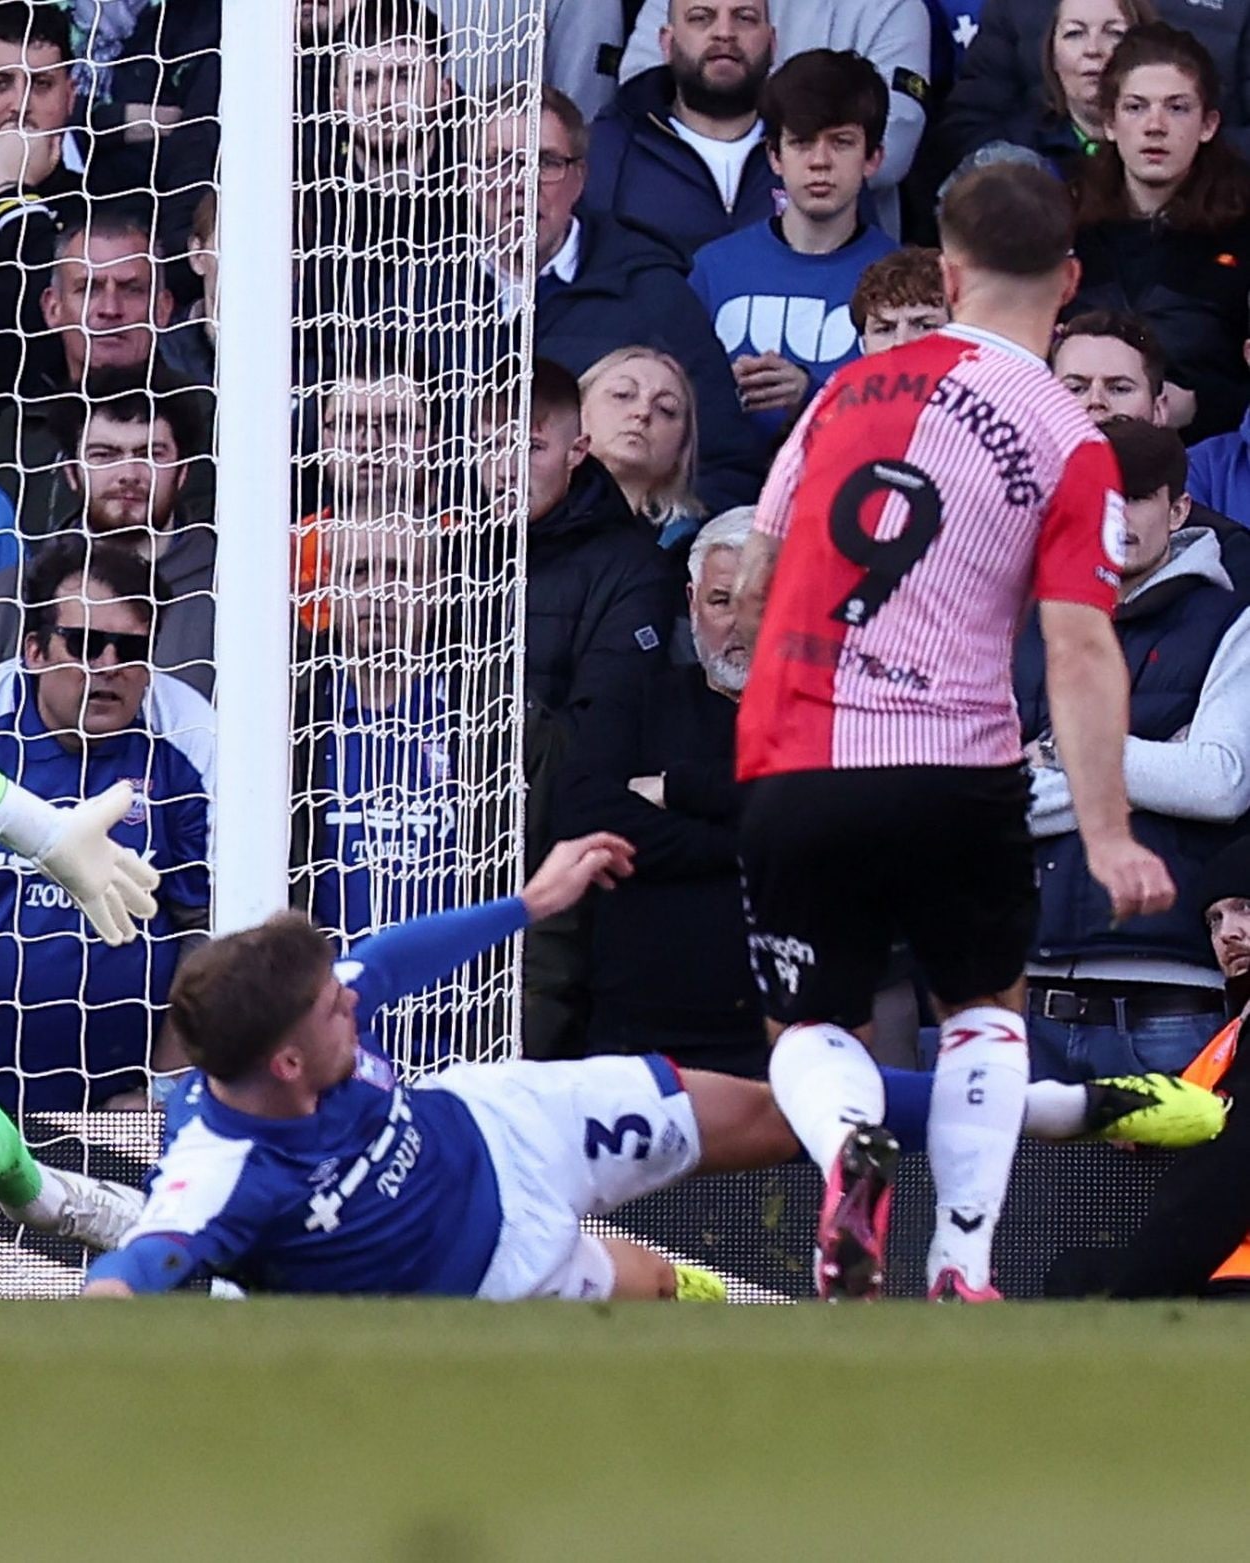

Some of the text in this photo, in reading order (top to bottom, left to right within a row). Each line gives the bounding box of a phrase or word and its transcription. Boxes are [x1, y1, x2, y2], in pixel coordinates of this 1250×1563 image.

[828, 459, 944, 627] 9
[25, 884, 81, 910] TOU
[377, 1125, 422, 1199] TOUR
[584, 1113, 652, 1160] 3
